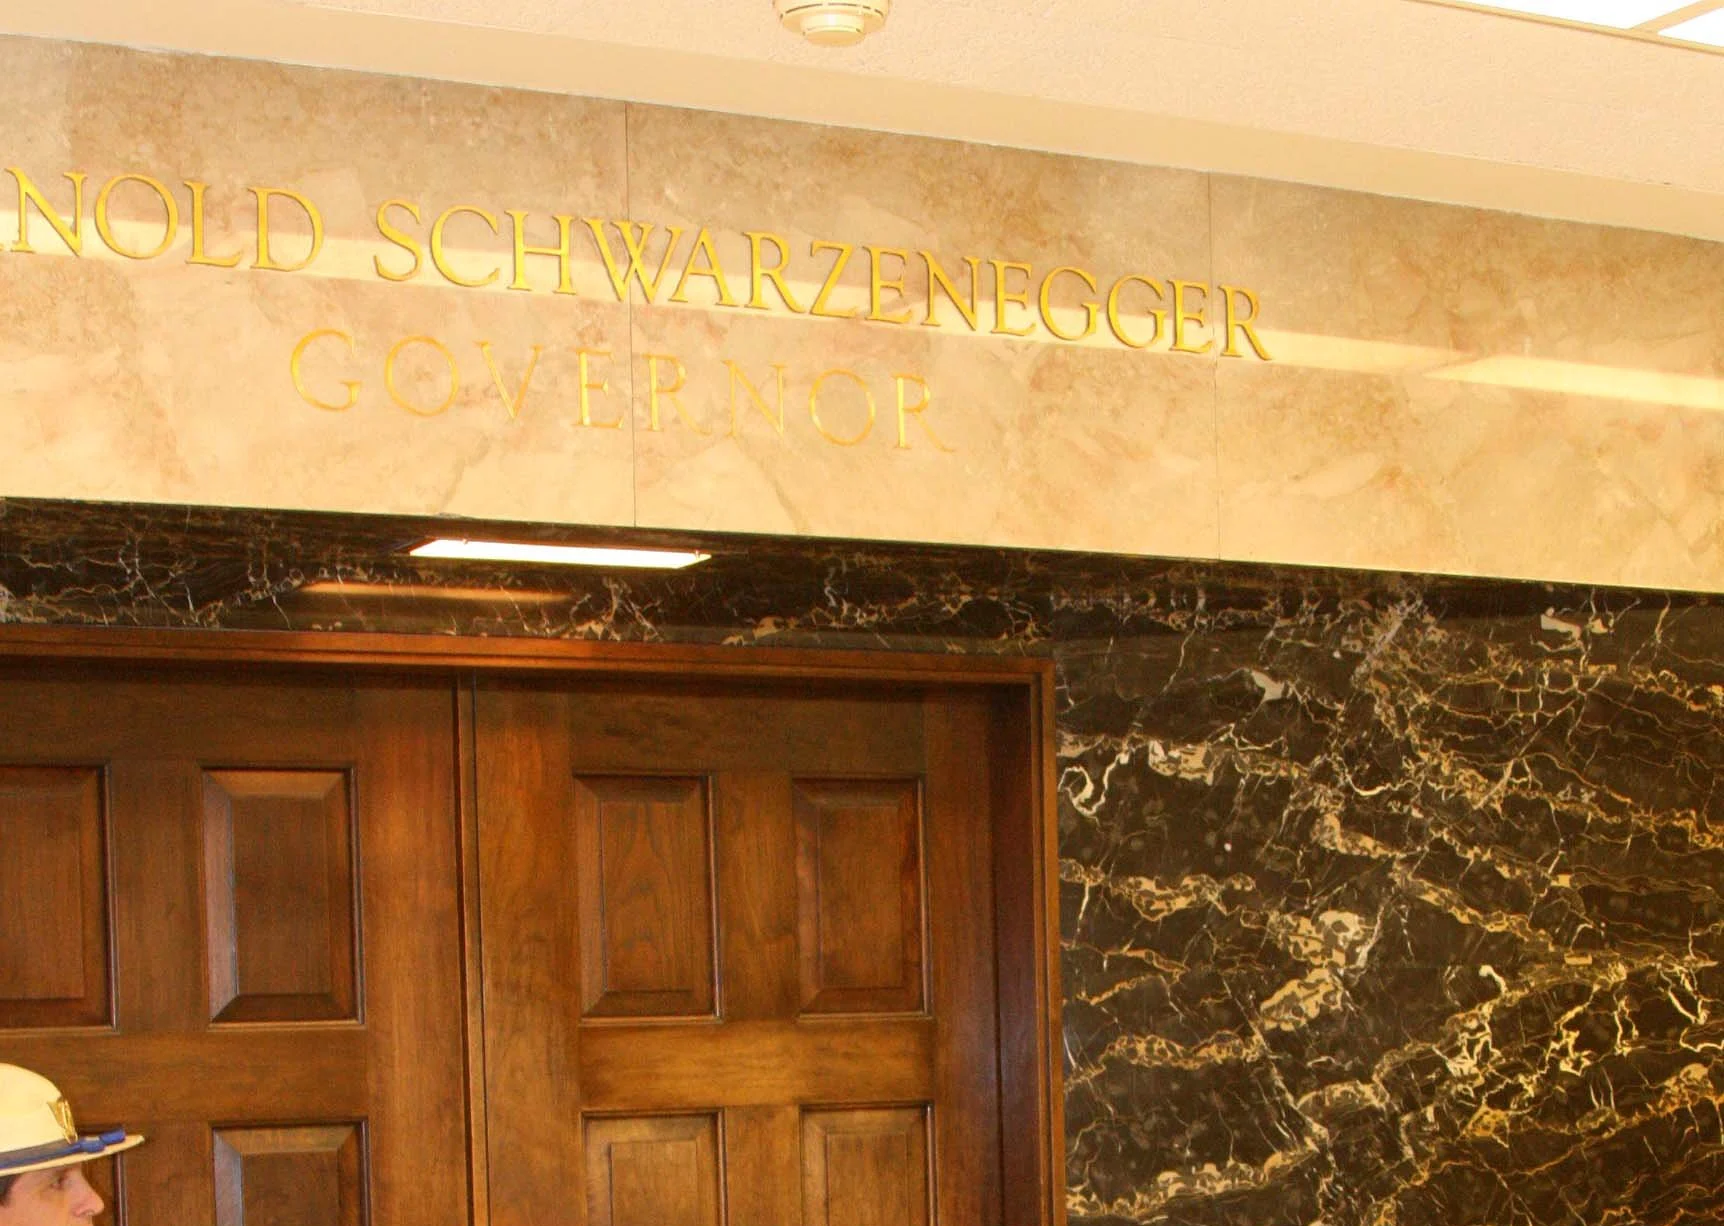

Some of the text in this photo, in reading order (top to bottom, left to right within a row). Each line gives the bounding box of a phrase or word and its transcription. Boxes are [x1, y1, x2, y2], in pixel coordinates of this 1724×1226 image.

[0, 166, 1272, 361] NOLD SCHWARZENEGGER
[290, 328, 955, 453] GOVERNOR
